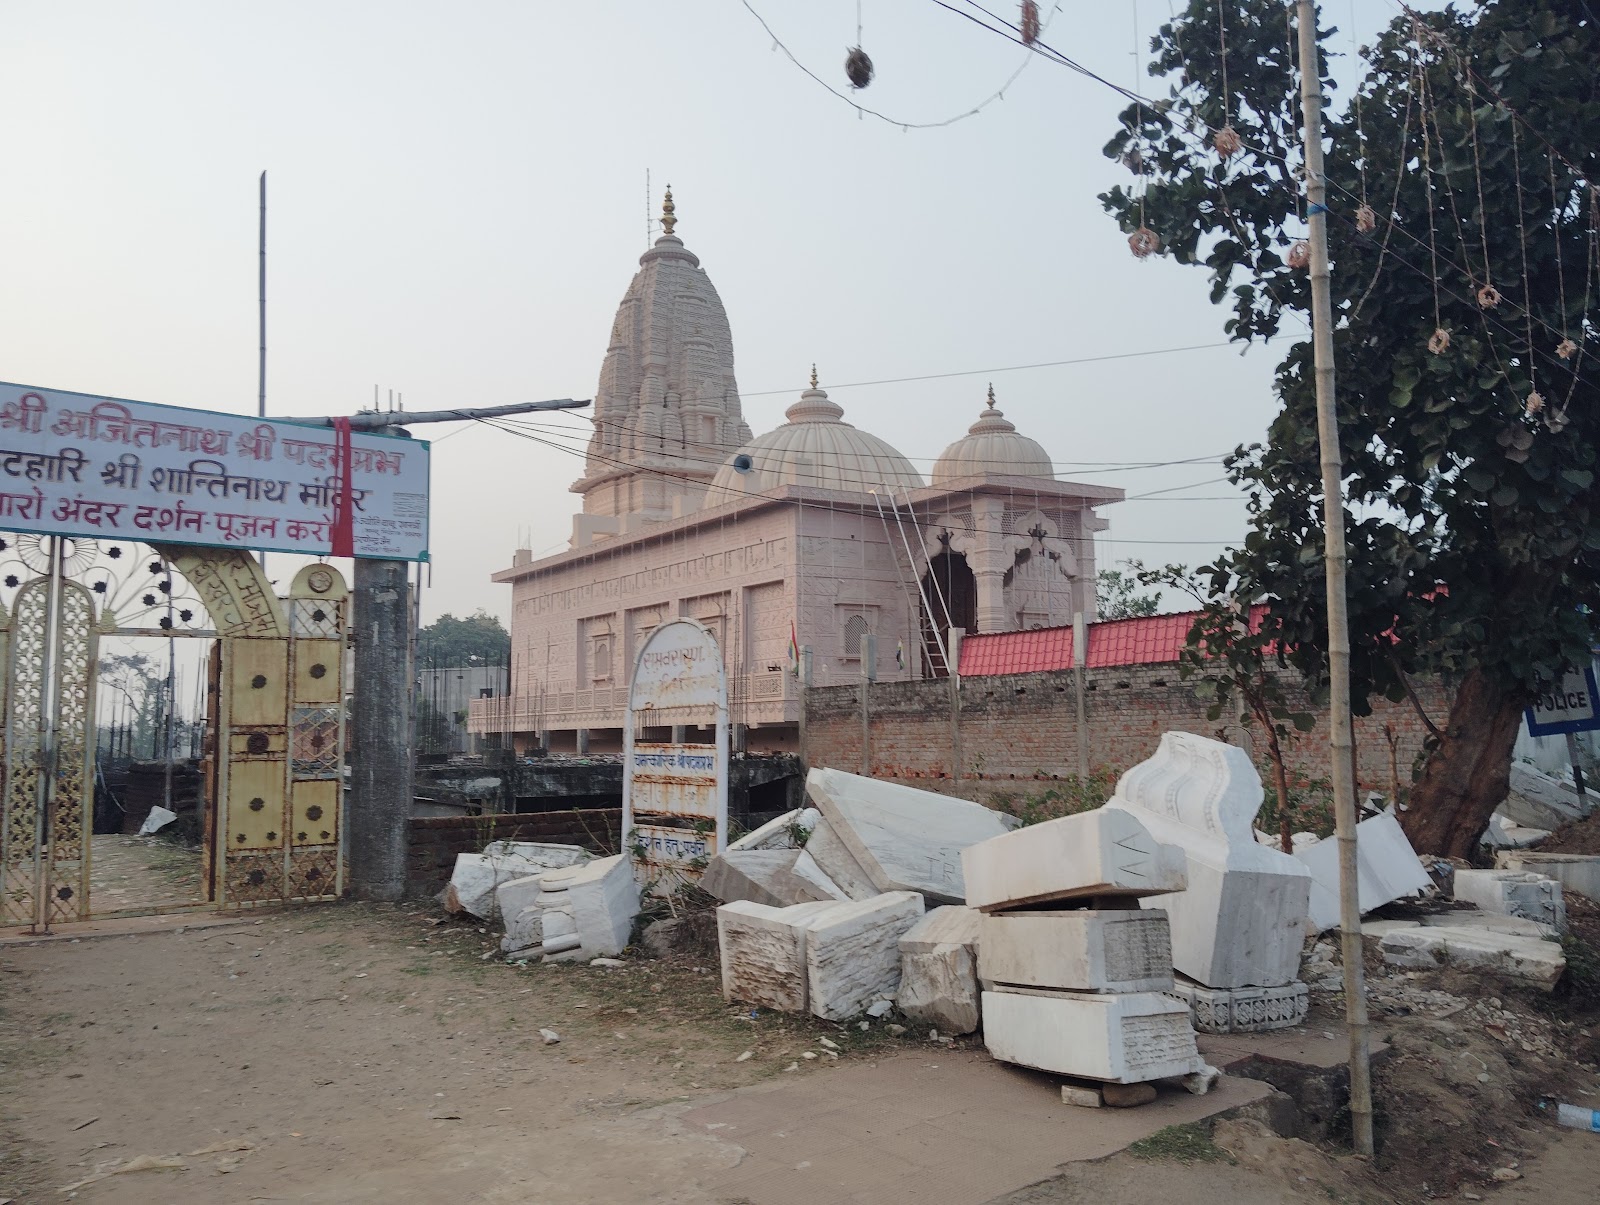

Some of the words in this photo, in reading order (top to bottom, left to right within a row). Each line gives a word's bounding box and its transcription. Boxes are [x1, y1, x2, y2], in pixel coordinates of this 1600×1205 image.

[0, 391, 48, 434] श्री
[51, 401, 233, 456] अजितनाथ
[235, 423, 276, 462] श्री
[0, 447, 89, 483] टहारि
[99, 452, 142, 489] श्री
[149, 458, 291, 504] शान्तिनाथ
[52, 493, 128, 528] अंदर
[286, 513, 334, 543] करो
[1535, 691, 1588, 713] POLICE
